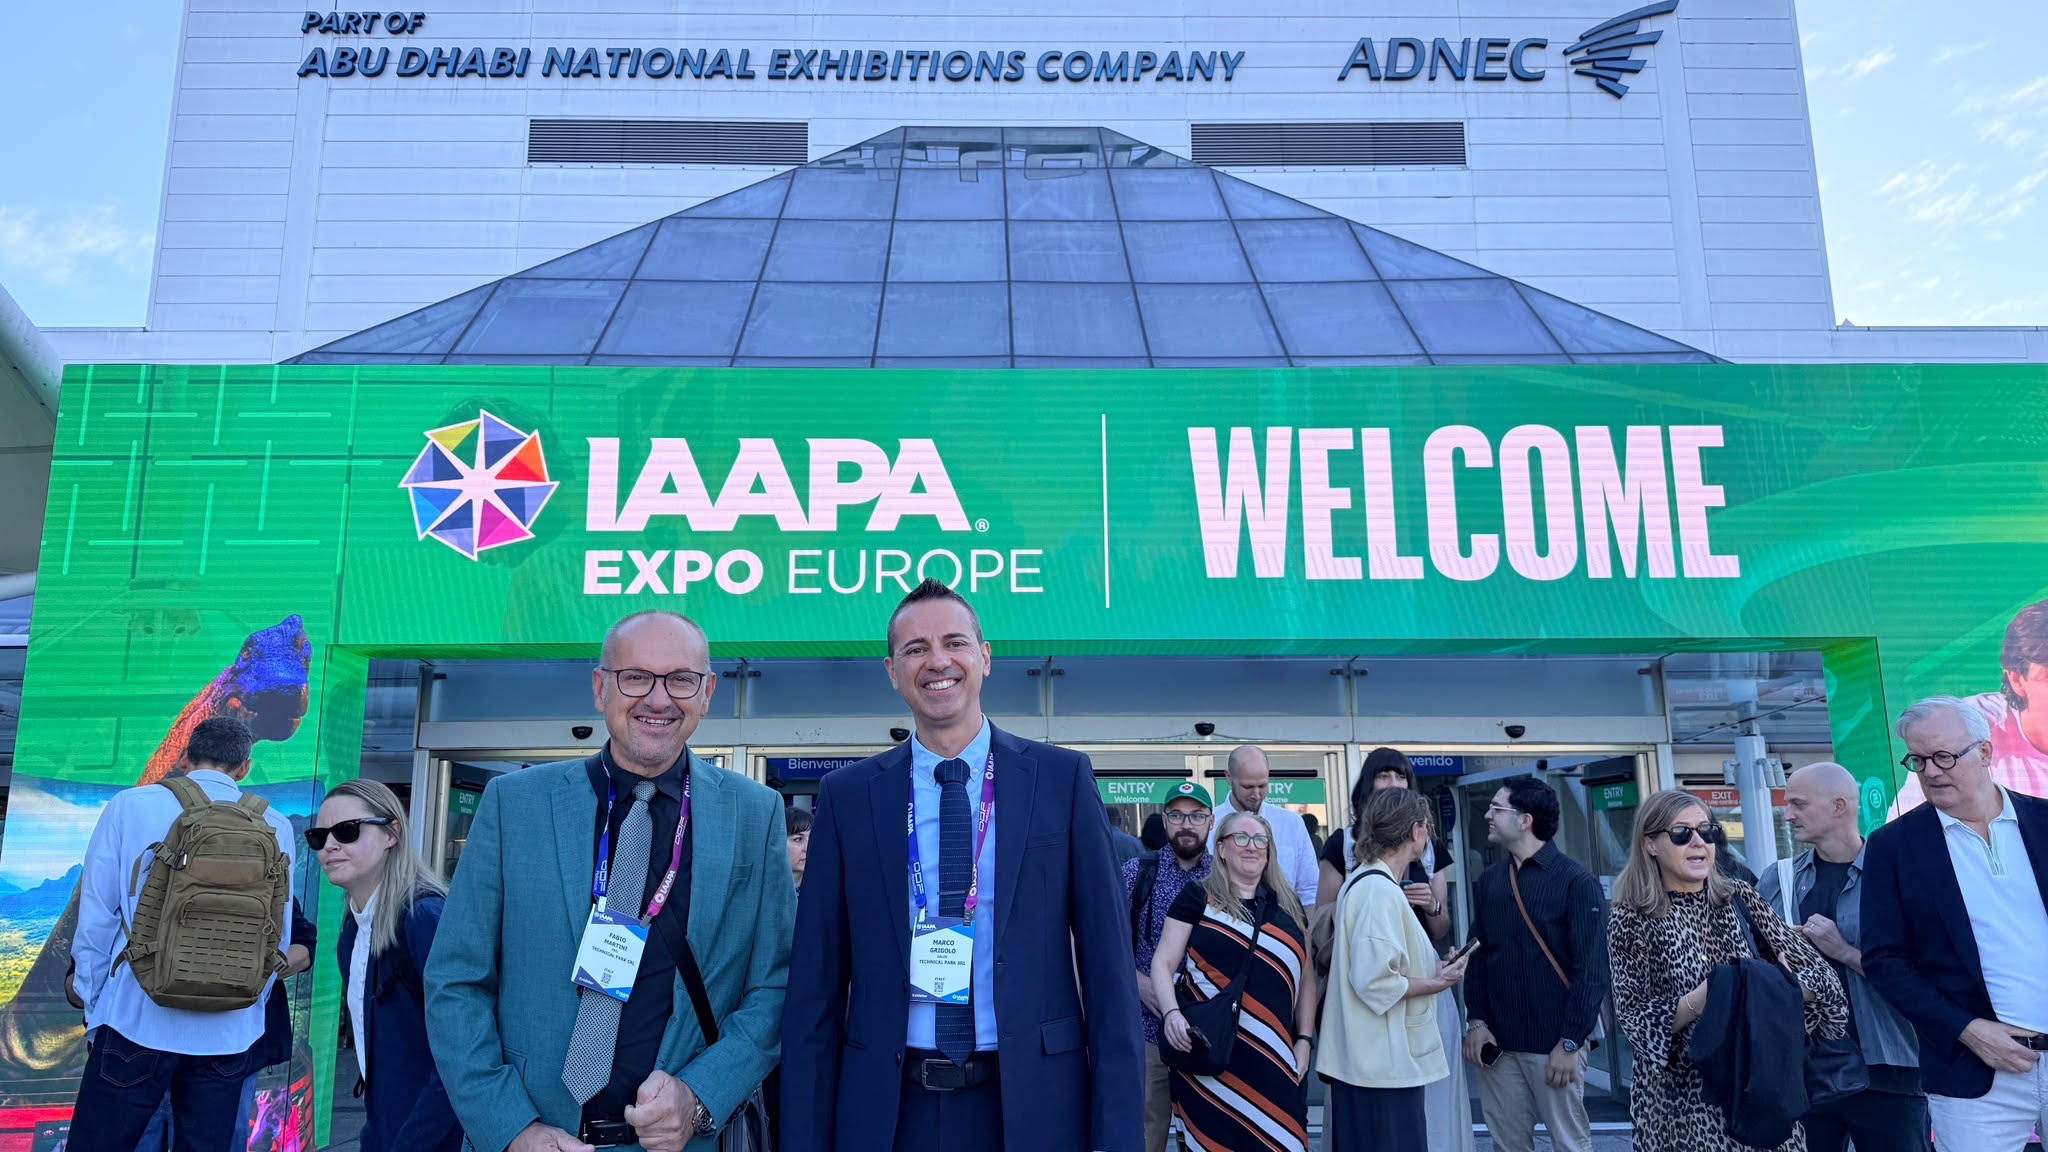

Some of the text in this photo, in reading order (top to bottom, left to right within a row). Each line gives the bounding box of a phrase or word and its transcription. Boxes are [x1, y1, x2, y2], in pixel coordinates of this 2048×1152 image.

[300, 10, 425, 34] PART OF
[298, 47, 1245, 81] ABU DHABI NATIONAL EXHIBITIONS COMPANY
[1338, 37, 1547, 82] ADNEC
[1187, 424, 1740, 581] WELCOME
[583, 548, 1044, 594] EXPO EUROPE
[788, 758, 855, 769] Bienvenue
[1409, 755, 1454, 767] venido
[1108, 782, 1155, 794] ENTRY
[1268, 782, 1294, 794] TRY
[1603, 785, 1624, 799] ENTRY
[459, 792, 476, 805] ENTRY
[1114, 795, 1150, 803] Welcome
[1711, 791, 1732, 800] EXIT
[661, 870, 676, 895] IAAPA
[609, 932, 627, 943] FABIO
[604, 939, 628, 952] MARTINI
[592, 946, 615, 959] TECHNICAL
